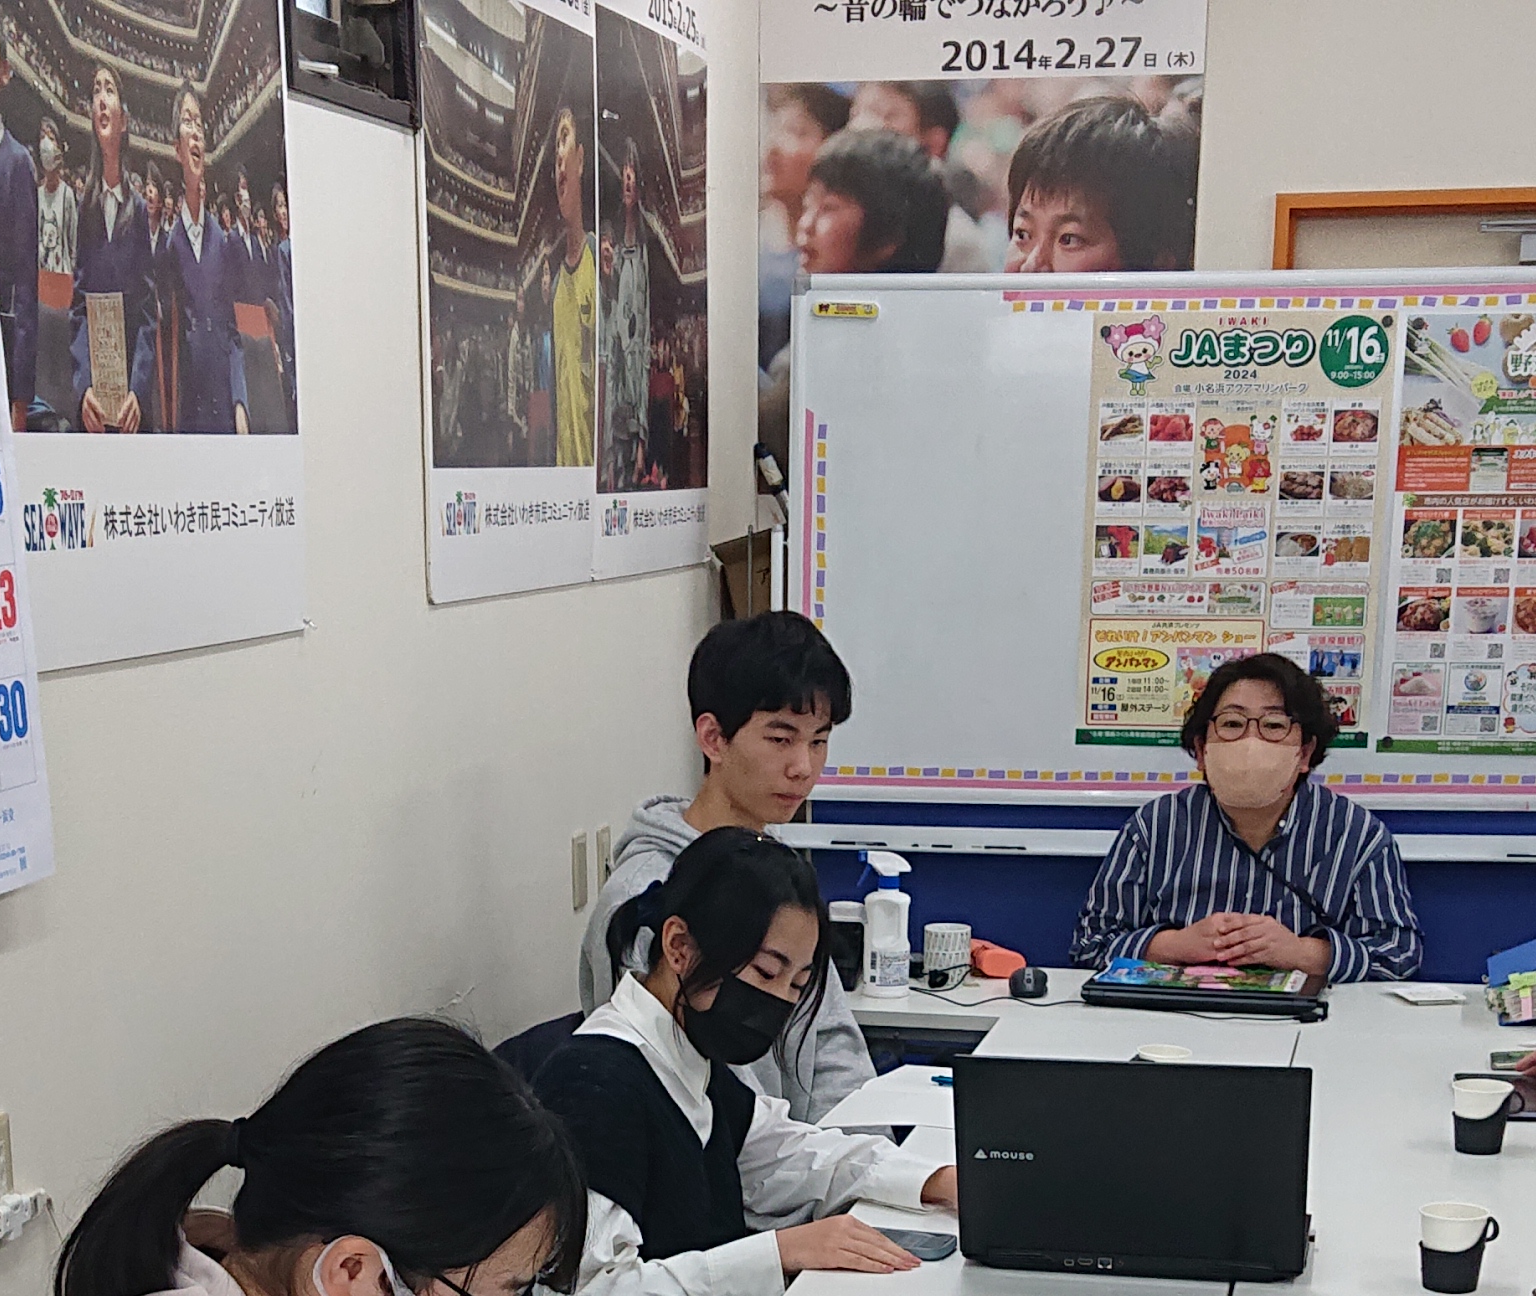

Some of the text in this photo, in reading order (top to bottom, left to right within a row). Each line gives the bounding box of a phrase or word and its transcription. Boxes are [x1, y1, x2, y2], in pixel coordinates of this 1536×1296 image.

[1219, 316, 1268, 326] IWAKI
[1170, 329, 1315, 367] JAまつり
[1325, 325, 1382, 364] 11/16
[1224, 370, 1257, 380] 2024
[1194, 383, 1308, 395] 小名浜アクアマリンパーク
[24, 502, 87, 551] SEA WAVE
[989, 1150, 1034, 1161] mouse
